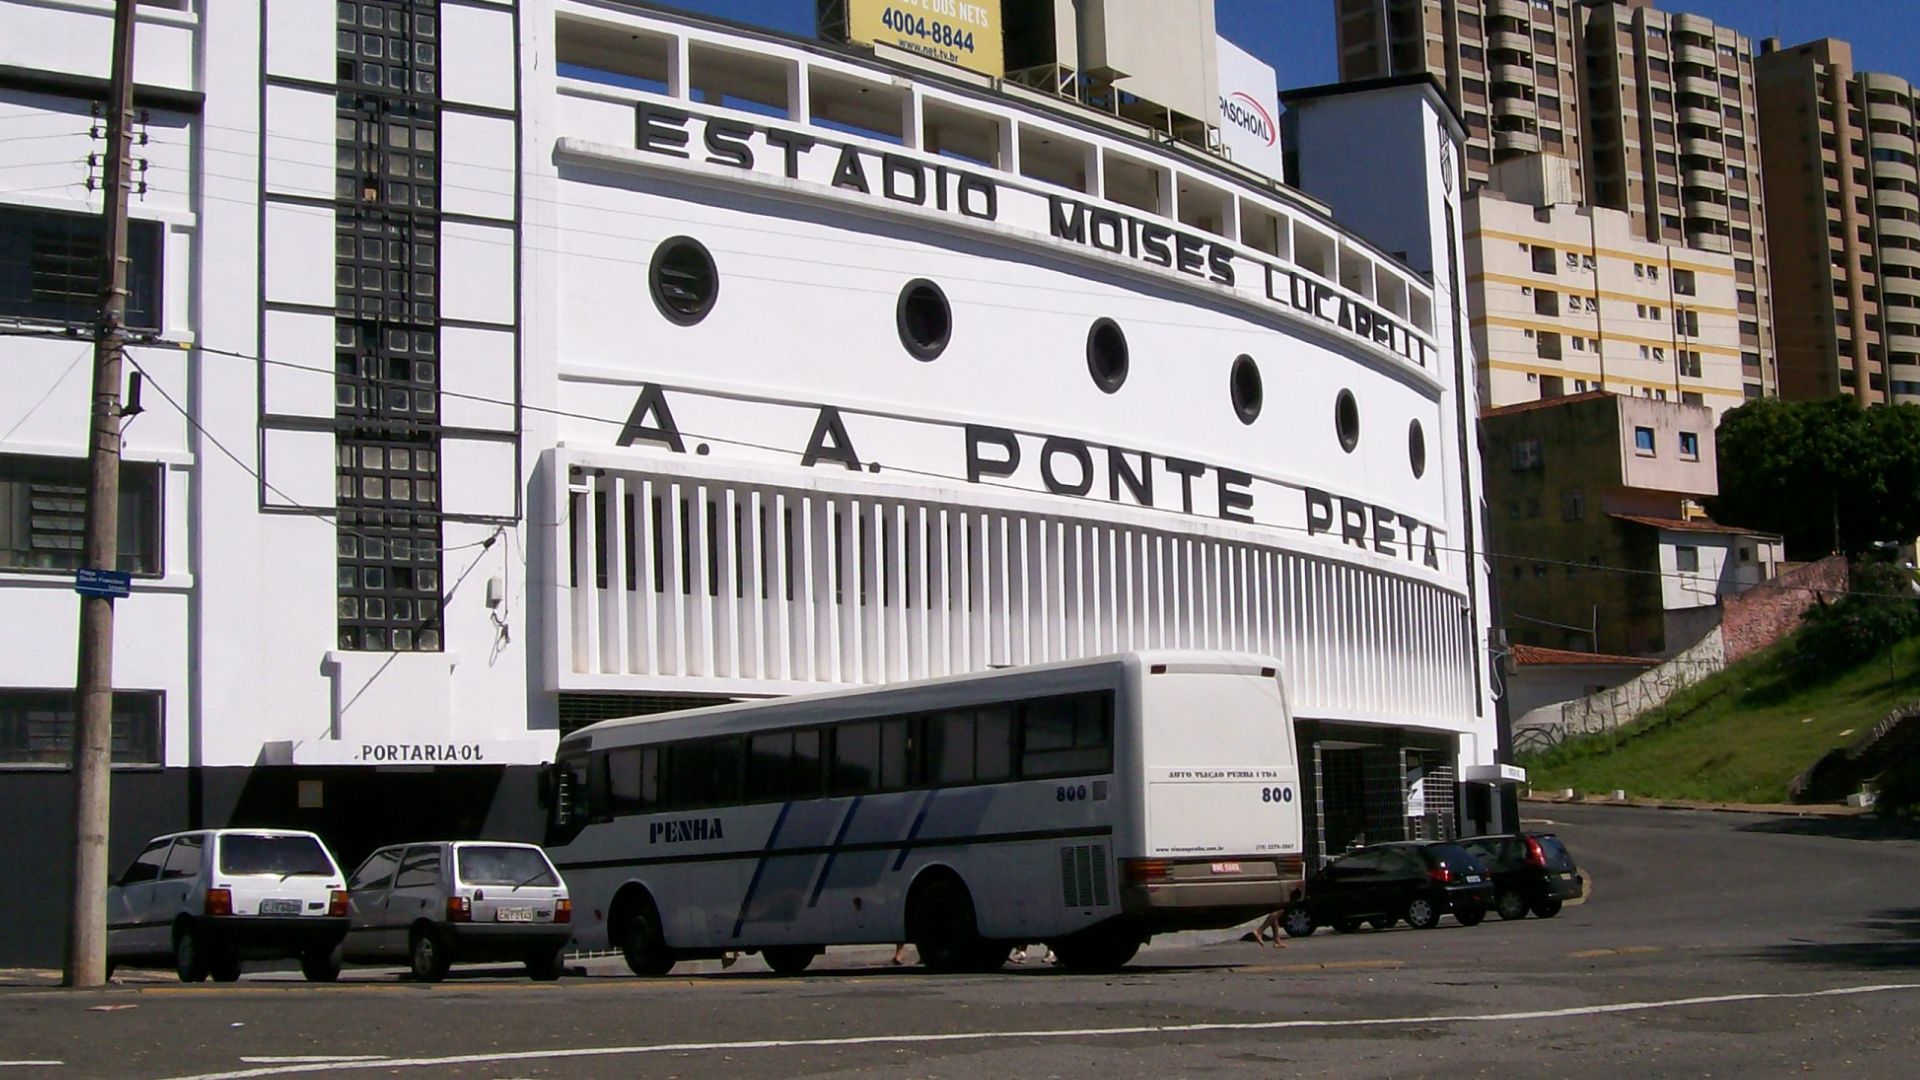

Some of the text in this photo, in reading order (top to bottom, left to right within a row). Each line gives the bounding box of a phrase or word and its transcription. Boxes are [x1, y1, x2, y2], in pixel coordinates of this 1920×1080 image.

[960, 1, 989, 28] NETS
[882, 7, 975, 54] 4004-8844
[898, 38, 959, 63] www.net.tv.br
[1218, 95, 1270, 142] PASCHOAL
[635, 101, 1426, 368] ESTADIO MOISES LUCARELLI
[615, 382, 1440, 571] A. A. PONTE PRETA
[1168, 771, 1192, 779] AUTO
[1226, 771, 1254, 779] PENHA
[1056, 784, 1086, 802] 800
[1261, 787, 1293, 803] 800
[649, 817, 723, 844] PENHA
